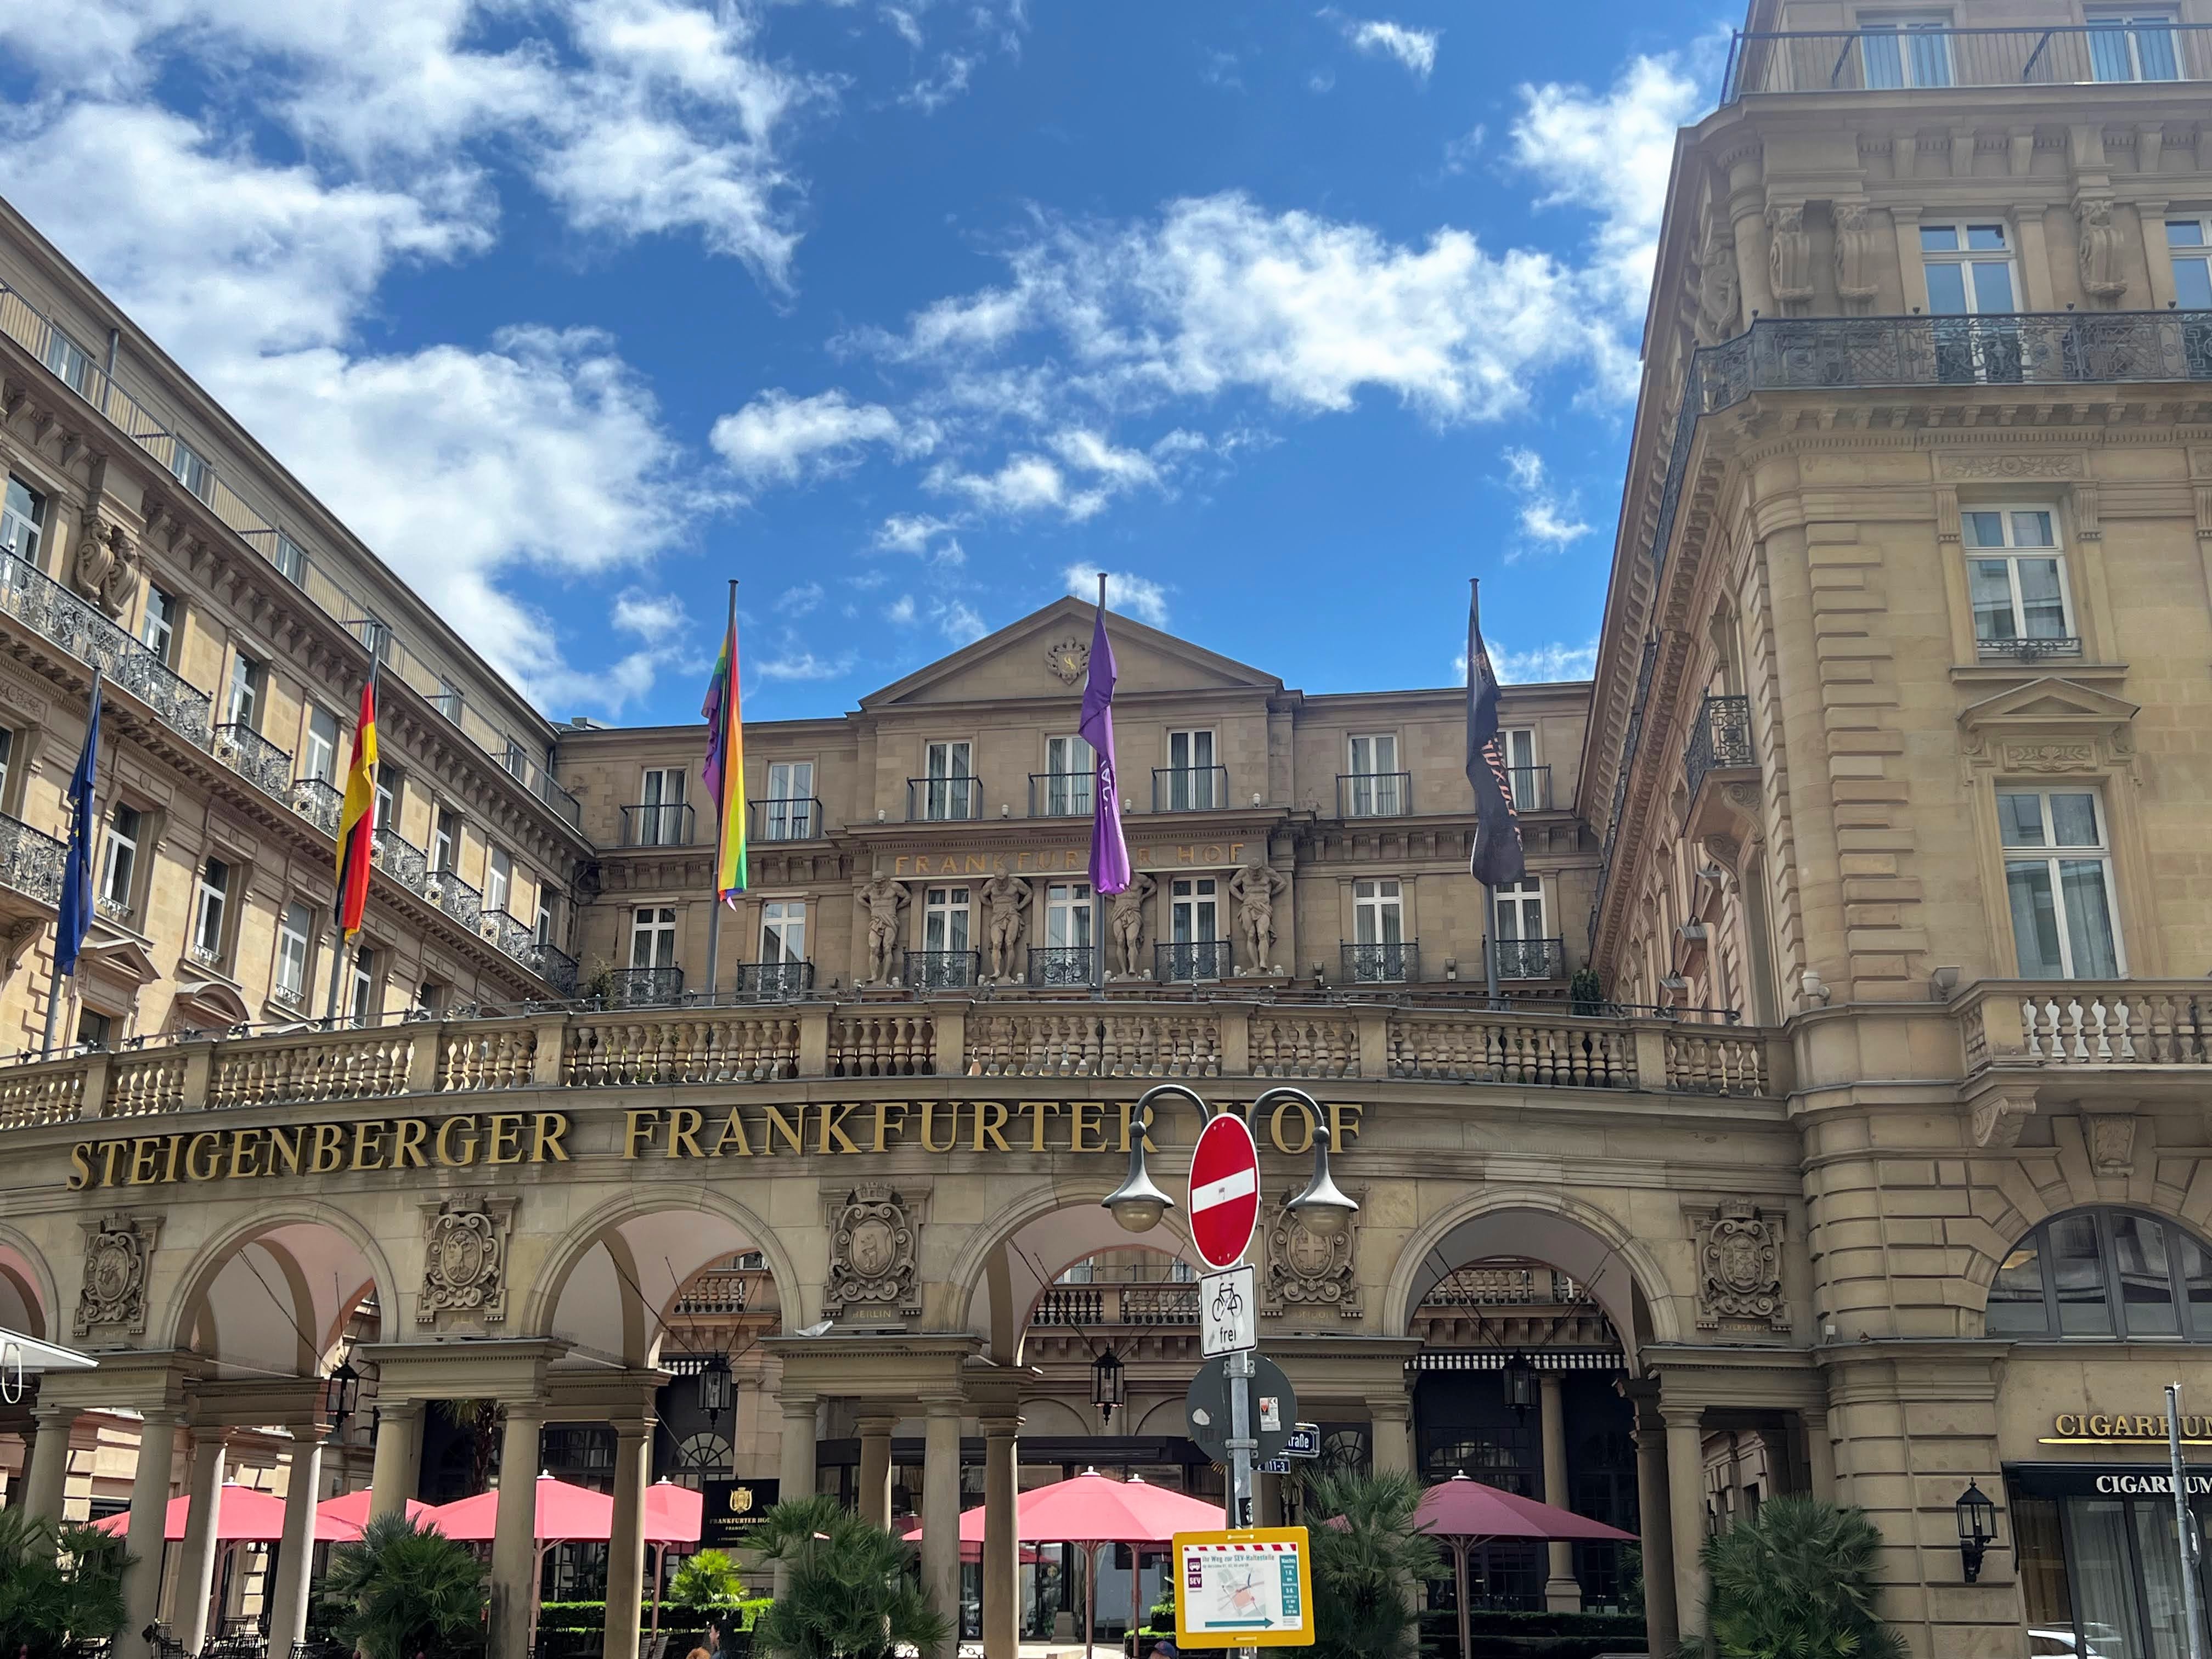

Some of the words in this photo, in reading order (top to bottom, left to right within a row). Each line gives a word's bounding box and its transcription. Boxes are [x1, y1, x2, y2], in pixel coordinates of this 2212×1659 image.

[895, 848, 1155, 876] FRANKFURR
[1177, 843, 1244, 865] HOF
[66, 1112, 569, 1191] STEIGENBERGER
[619, 1101, 1159, 1159] FRANKFURTER
[1211, 1101, 1363, 1154] OF
[1220, 1327, 1237, 1344] frei
[1189, 1577, 1201, 1585] SEV
